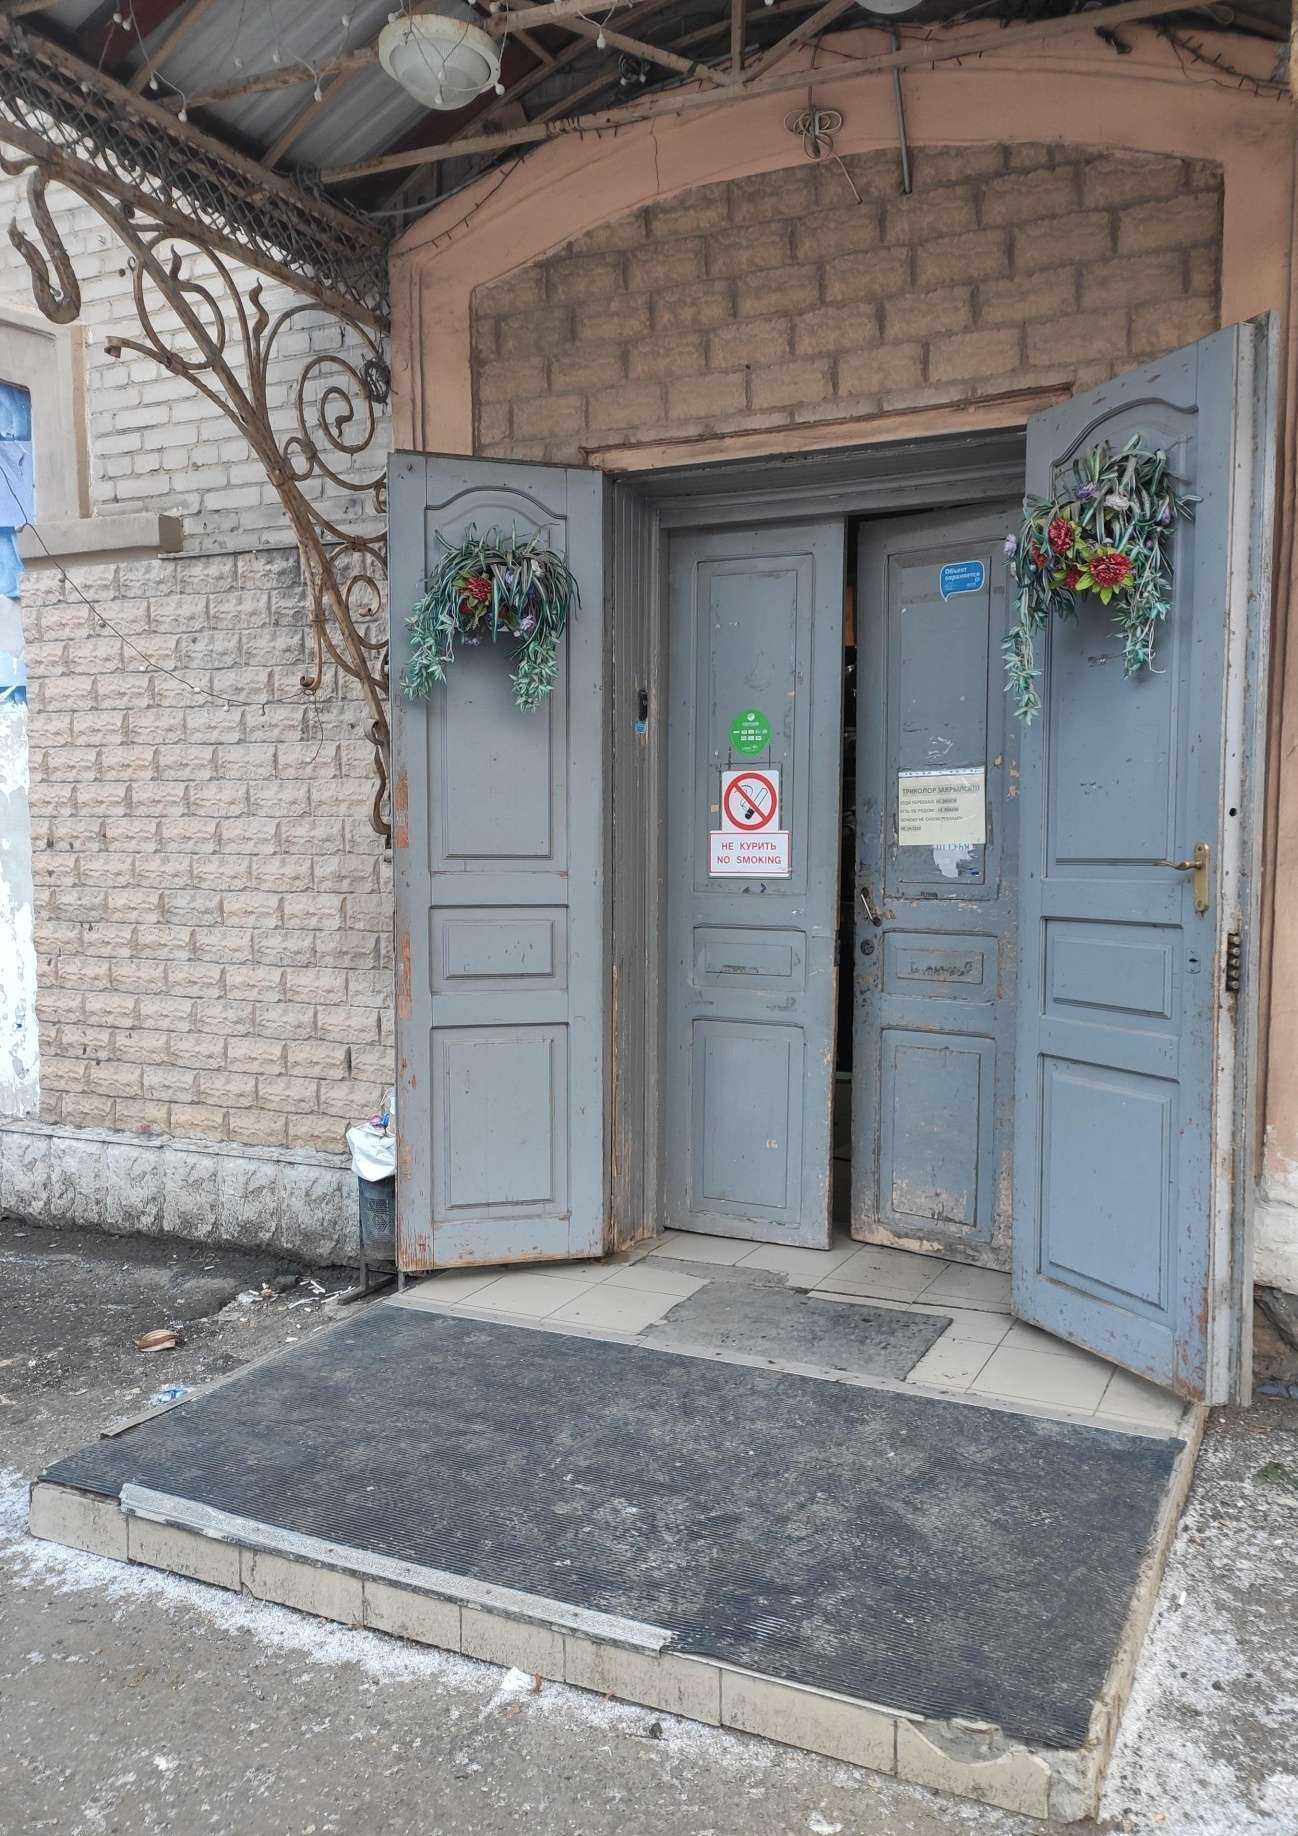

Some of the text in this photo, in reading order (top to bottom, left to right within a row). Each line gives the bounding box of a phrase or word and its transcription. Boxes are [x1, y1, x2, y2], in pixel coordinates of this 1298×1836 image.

[902, 788, 936, 796] ТРИКОЛОР
[721, 841, 777, 850] НЕ КУРИТЬ
[717, 855, 782, 865] NO SMOKING
